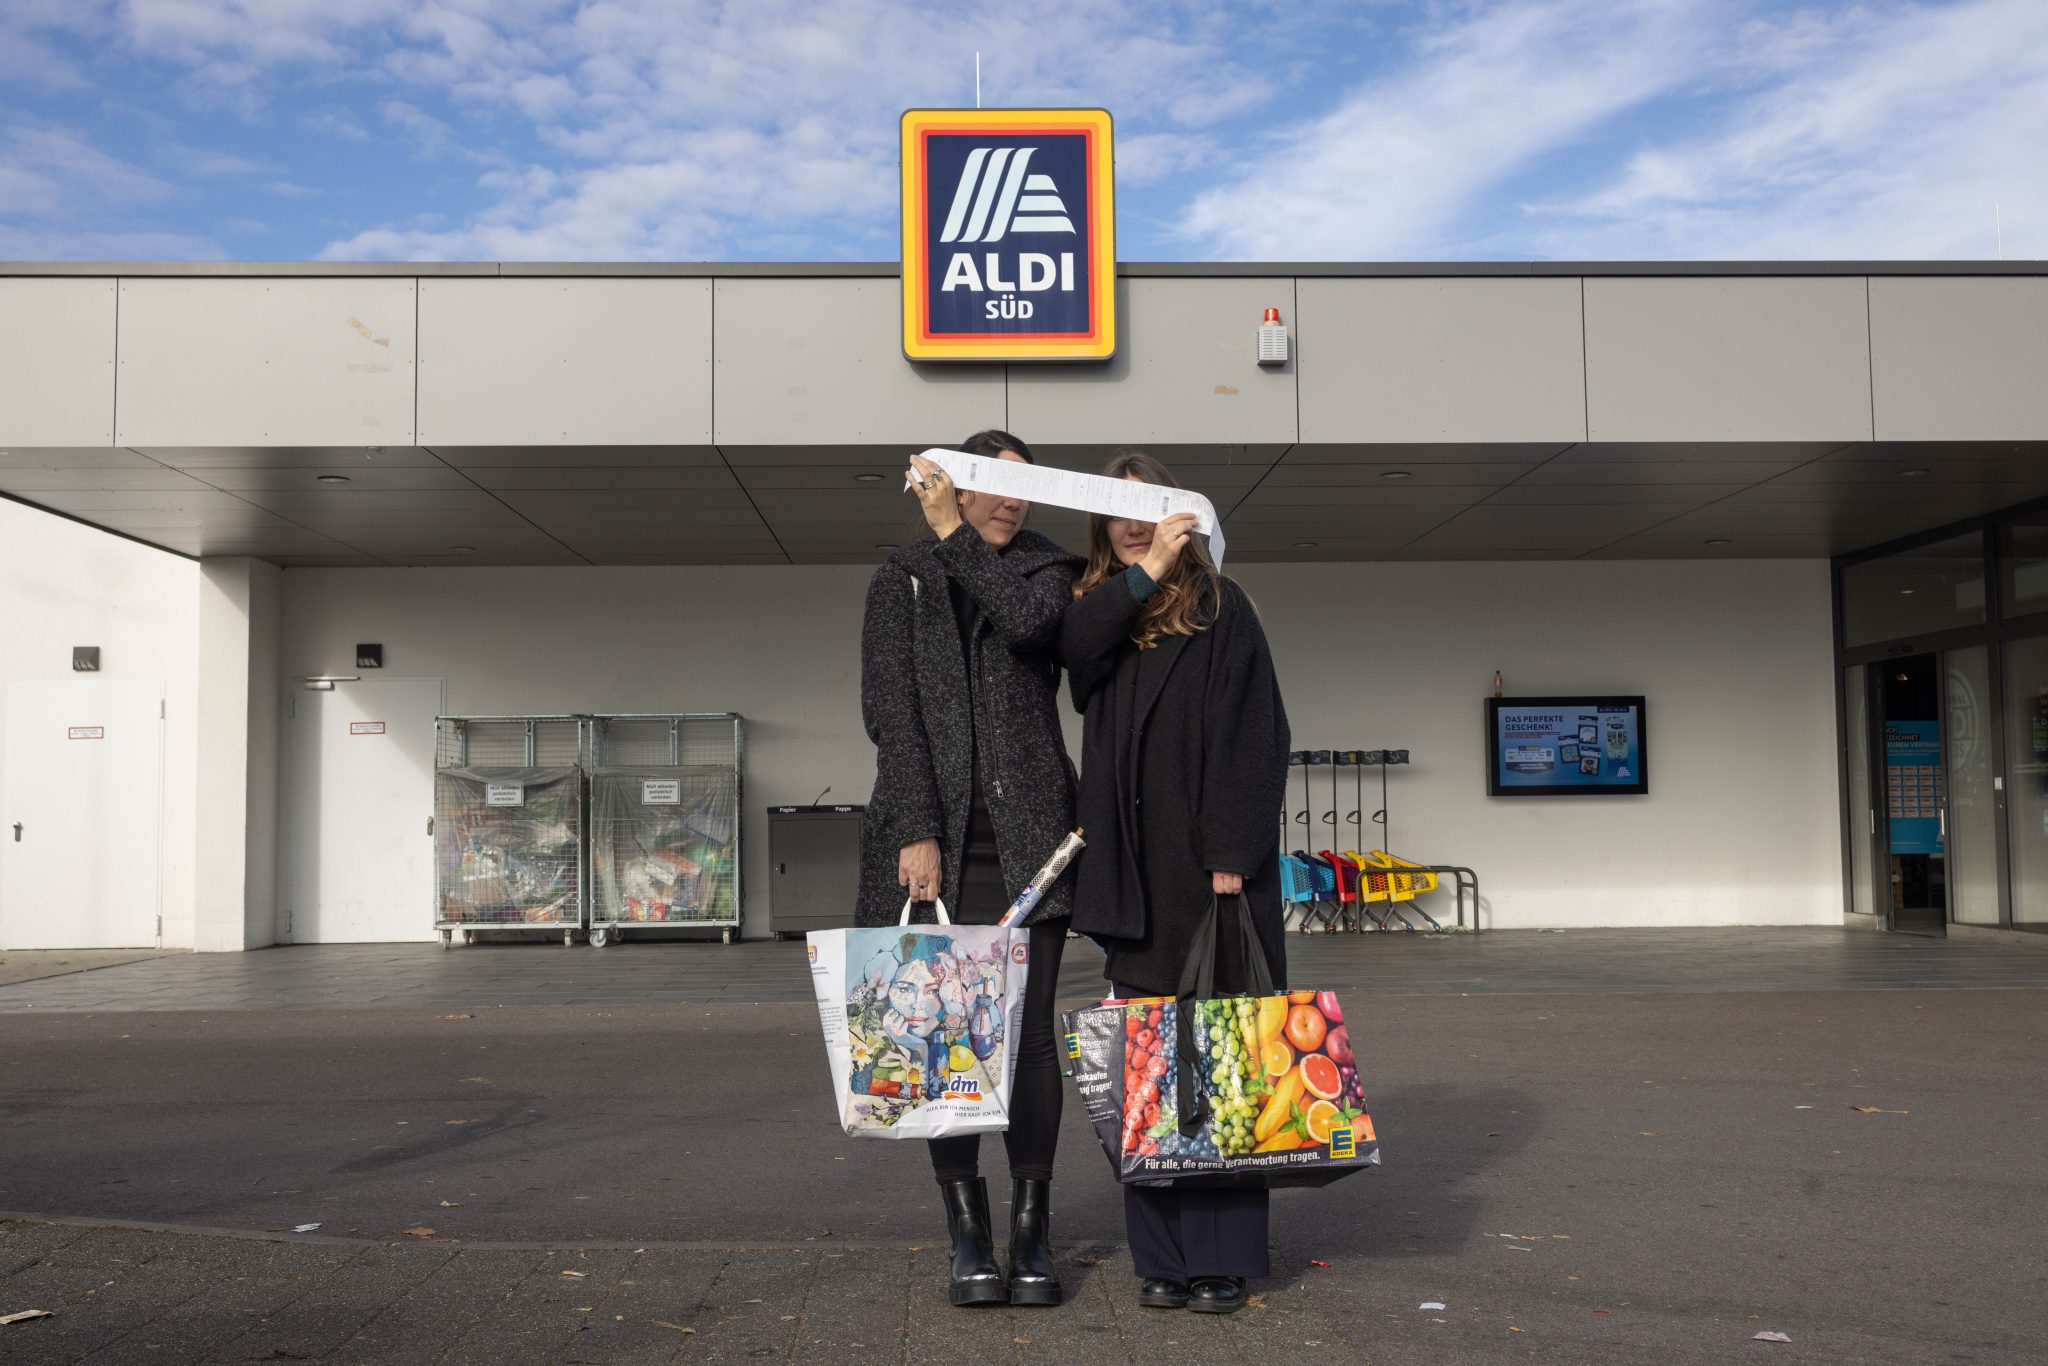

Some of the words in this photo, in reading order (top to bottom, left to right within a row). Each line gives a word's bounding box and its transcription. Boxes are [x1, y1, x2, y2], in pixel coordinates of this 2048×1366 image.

[941, 252, 1075, 292] ALDI
[985, 294, 1034, 319] SÜD
[1505, 715, 1522, 723] DAS
[1523, 715, 1565, 723] PERFEKTE
[1505, 723, 1553, 731] GESCHENK!
[950, 1075, 978, 1092] dm
[1090, 1081, 1113, 1093] tragen!
[1145, 1158, 1160, 1170] Für
[1161, 1158, 1181, 1171] alle,
[1182, 1159, 1196, 1169] die
[1197, 1161, 1223, 1170] gerne
[1225, 1153, 1288, 1169] Verantwortung
[1289, 1151, 1321, 1163] tragen.
